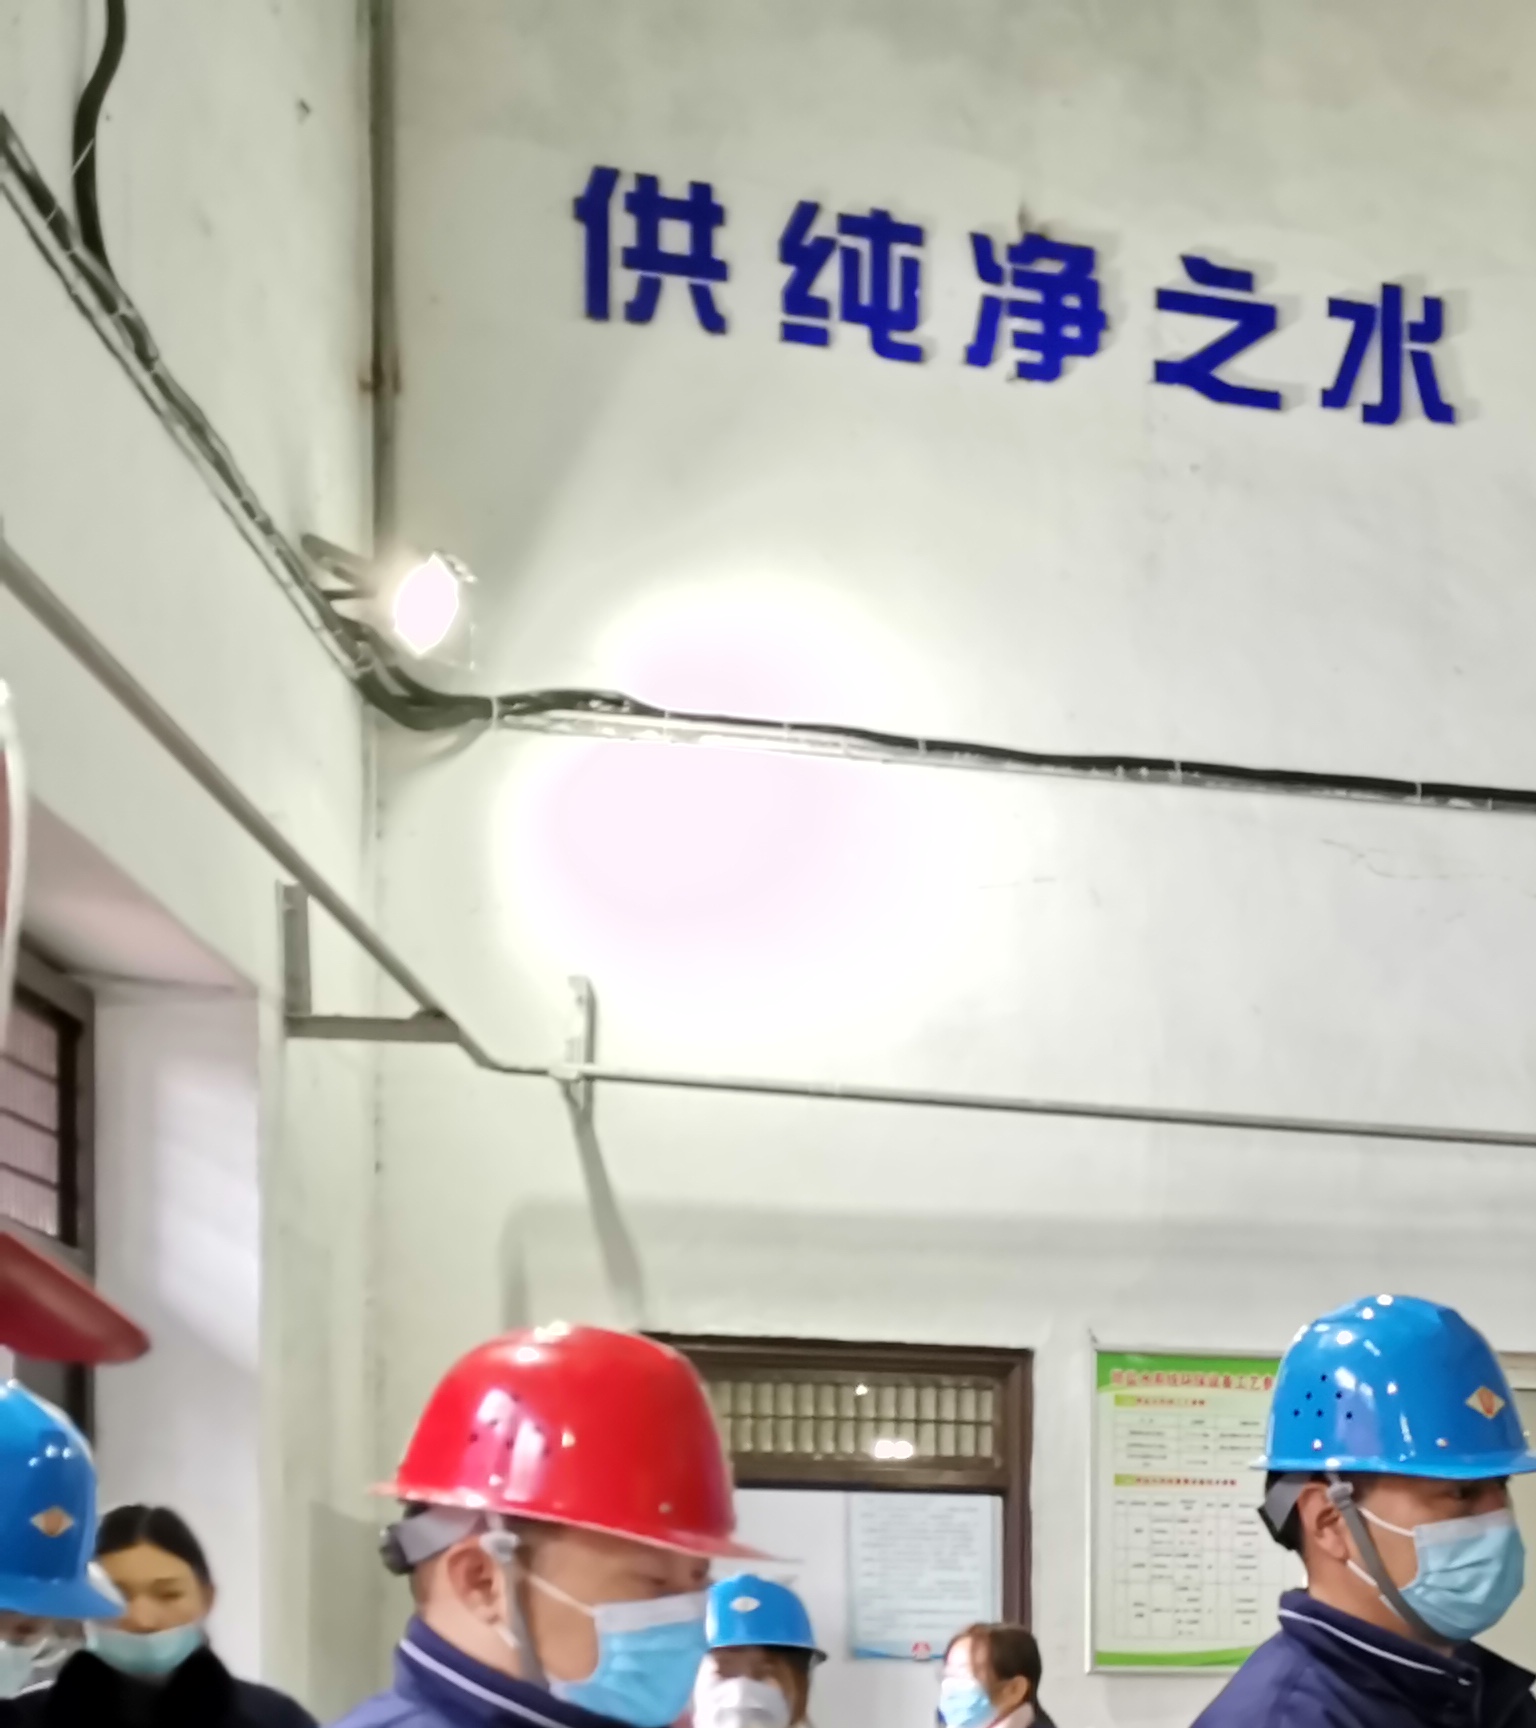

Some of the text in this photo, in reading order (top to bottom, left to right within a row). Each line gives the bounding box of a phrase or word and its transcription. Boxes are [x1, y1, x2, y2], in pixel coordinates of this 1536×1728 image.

[575, 165, 1456, 428] 供纯净之水
